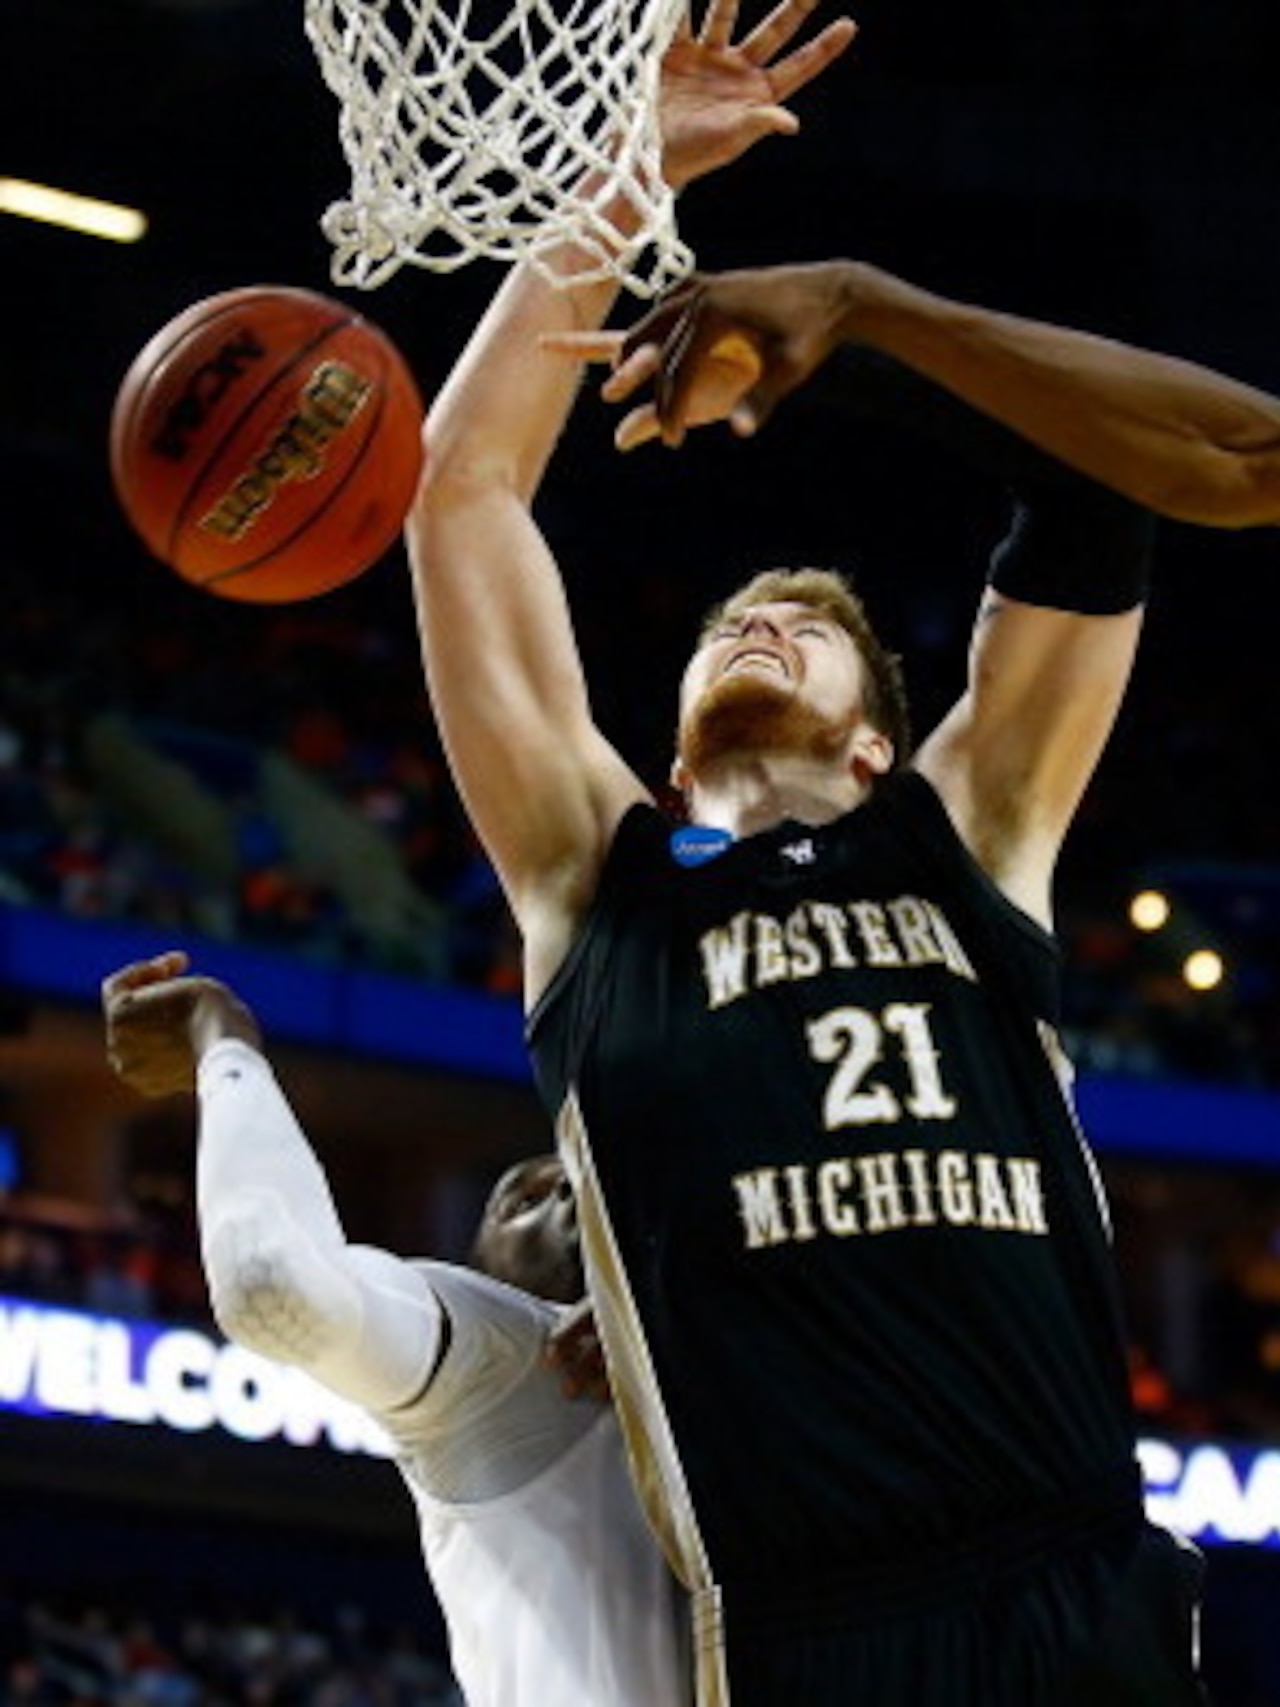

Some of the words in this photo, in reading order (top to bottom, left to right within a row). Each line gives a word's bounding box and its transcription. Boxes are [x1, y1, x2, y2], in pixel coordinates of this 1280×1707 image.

[198, 359, 371, 542] Wilson
[699, 895, 978, 1010] WESTERN
[805, 1002, 957, 1132] 21
[731, 1149, 1048, 1249] MICHIGAN
